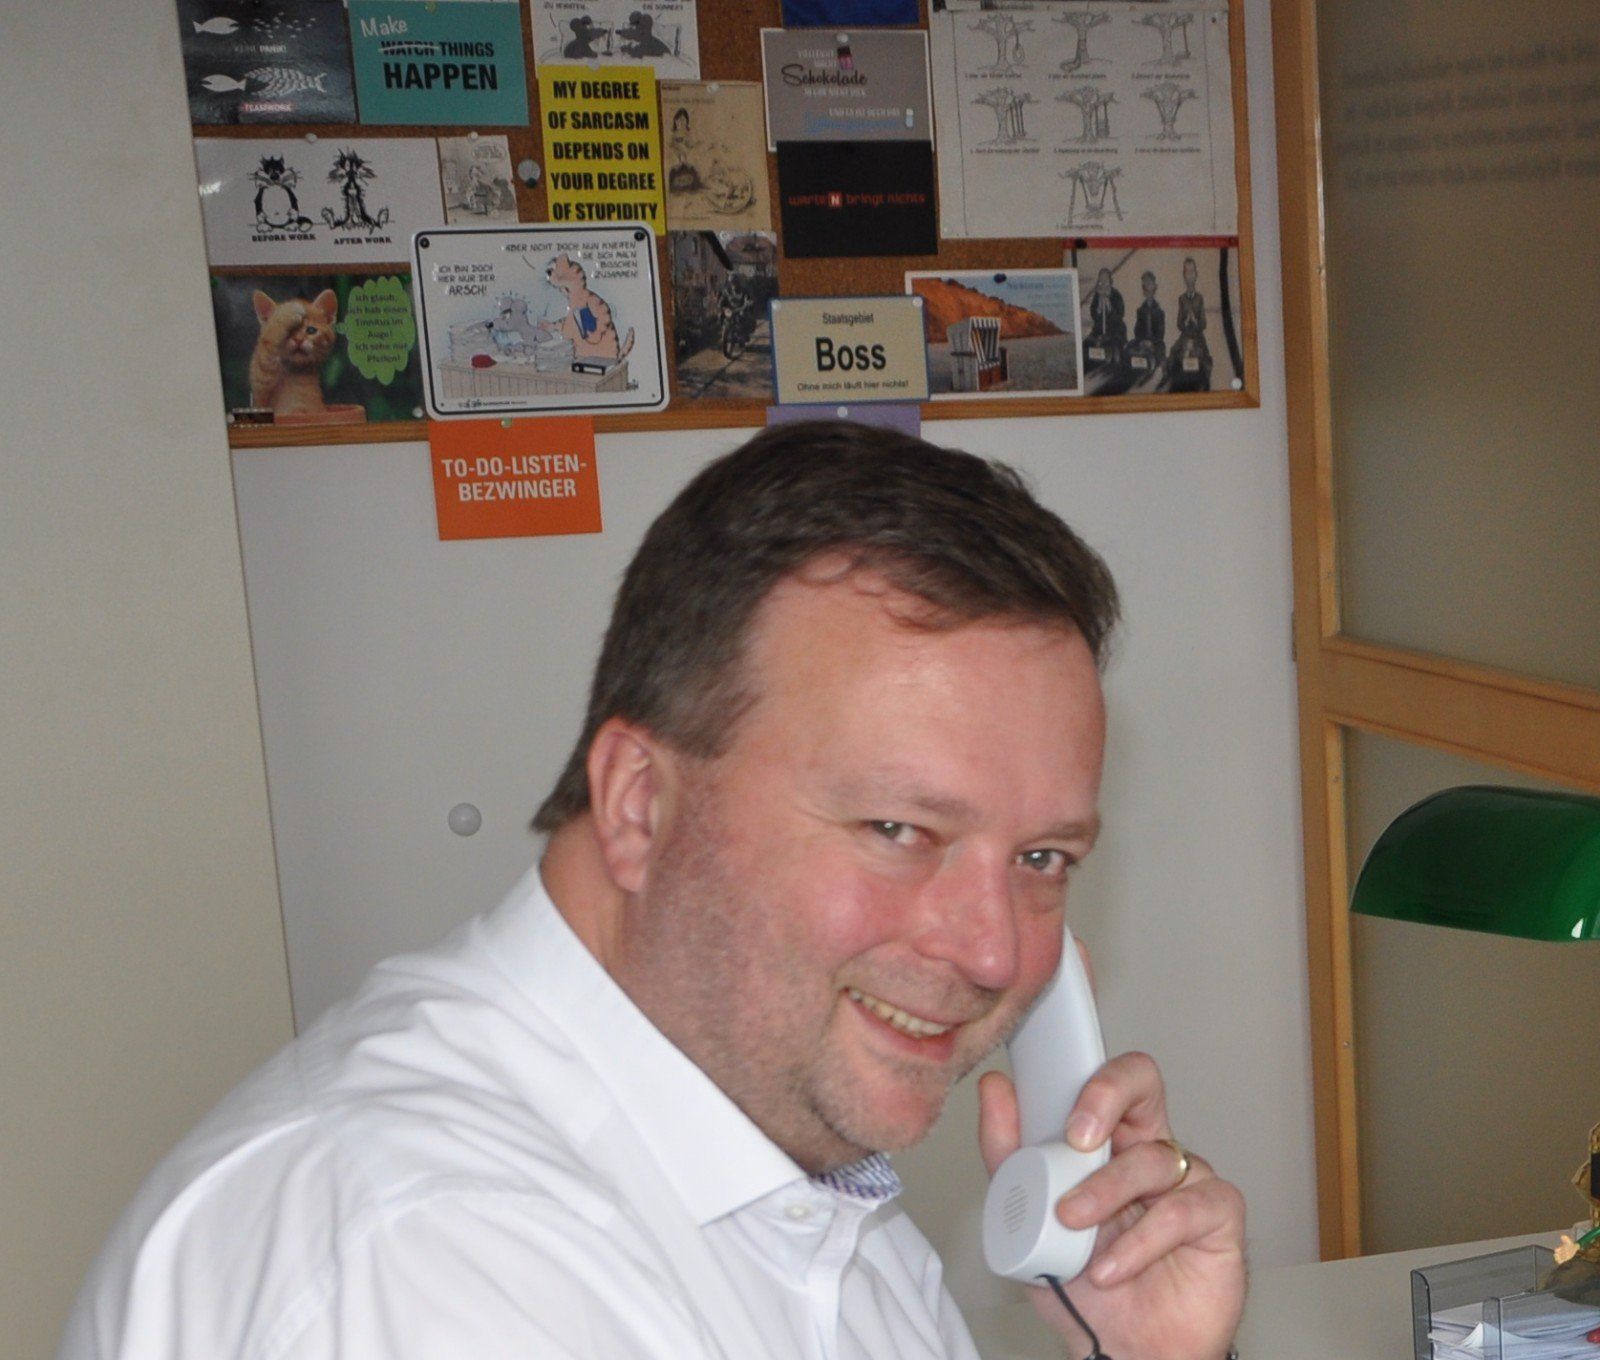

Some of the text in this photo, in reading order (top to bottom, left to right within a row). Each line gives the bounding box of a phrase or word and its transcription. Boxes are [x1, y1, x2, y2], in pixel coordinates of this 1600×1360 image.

[361, 16, 408, 38] Make
[440, 41, 494, 58] THINGS
[382, 62, 498, 91] HAPPEN
[781, 64, 869, 87] Schokolade
[553, 81, 577, 99] MY
[580, 81, 641, 100] DEGREE
[548, 110, 650, 131] OF SARCASM
[552, 142, 650, 161] DEPENDS ON
[550, 171, 656, 191] YOUR DEGREE
[552, 202, 659, 222] OF STUPIDITY
[252, 233, 316, 243] BEFORE WORK
[333, 236, 392, 246] AFTER WORK
[529, 242, 553, 252] NICHT
[437, 273, 496, 283] HIER NUR DER
[438, 264, 494, 273] ICH BIN DOCH
[448, 285, 488, 296] ARSCH!
[822, 312, 874, 327] Staatsgebiet
[815, 336, 887, 372] Boss
[797, 382, 820, 391] Ohne
[822, 381, 842, 390] mich
[843, 380, 862, 389] läuft
[864, 380, 880, 389] hier
[440, 454, 588, 480] TO-DO-LISTEN-
[457, 478, 577, 502] BEZWINGER
